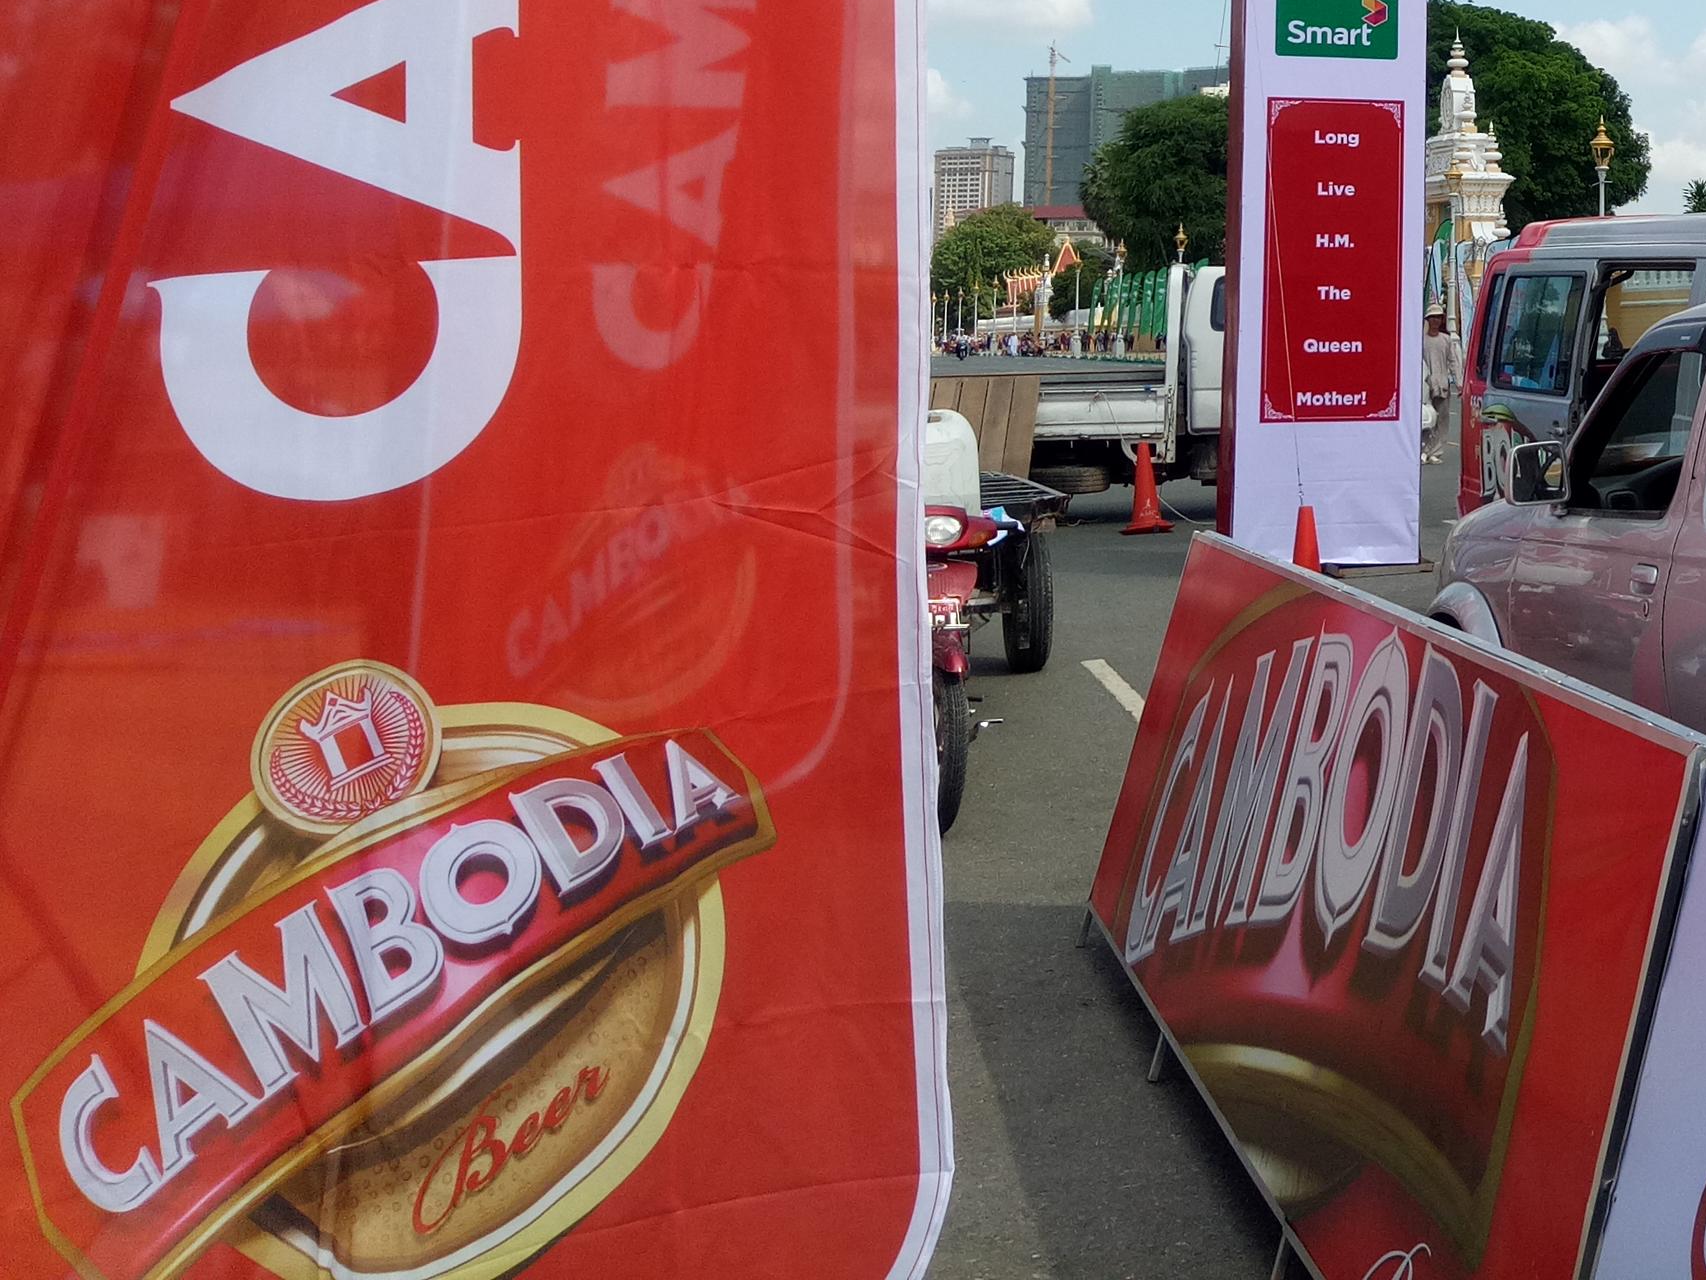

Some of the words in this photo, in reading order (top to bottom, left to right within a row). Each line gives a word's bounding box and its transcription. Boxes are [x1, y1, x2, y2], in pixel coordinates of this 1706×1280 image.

[1286, 20, 1373, 46] Smart
[1314, 130, 1360, 148] Long
[1317, 182, 1356, 196] Live
[1315, 233, 1355, 248] H.M.
[1317, 285, 1352, 300] The
[1303, 338, 1363, 353] Queen
[1296, 391, 1367, 406] Mother!
[1125, 619, 1531, 1057] CAMBODIA
[58, 738, 743, 1215] CAMBODIA
[412, 1061, 612, 1237] Beer
